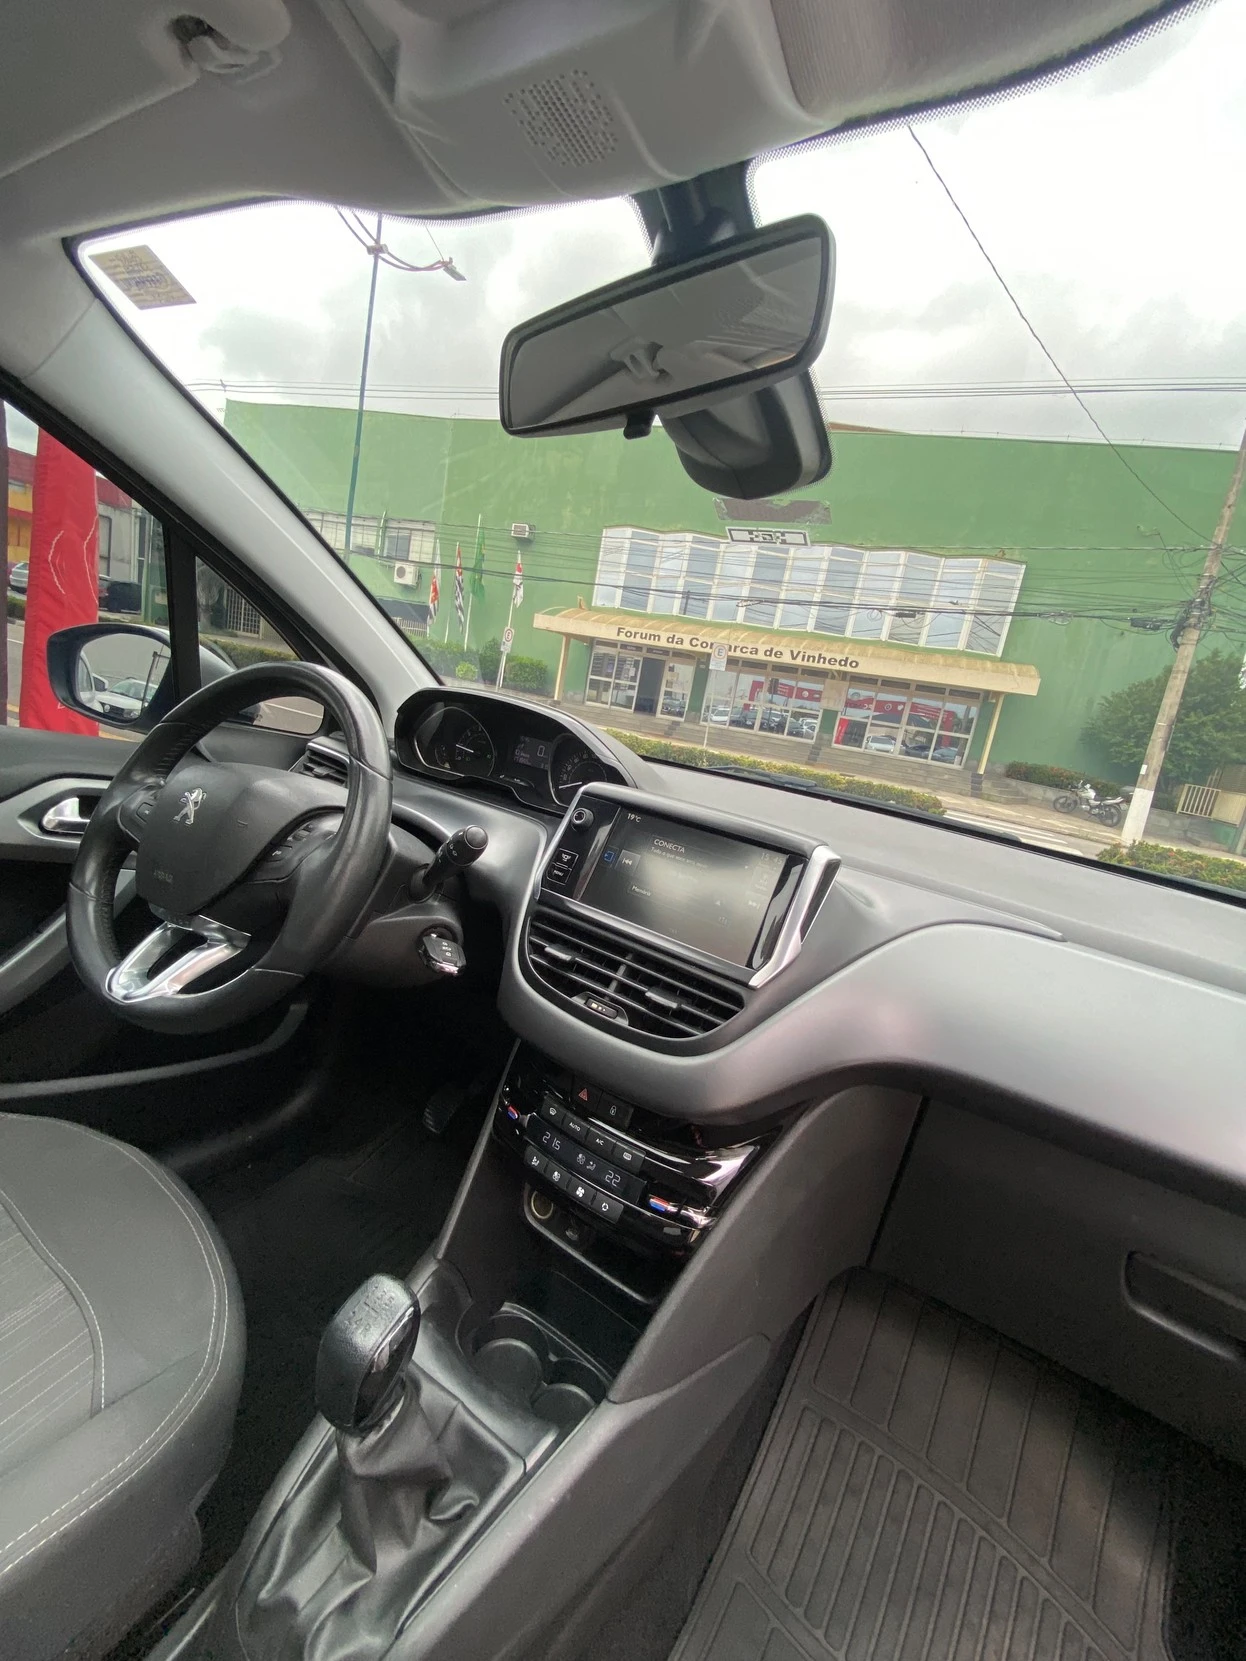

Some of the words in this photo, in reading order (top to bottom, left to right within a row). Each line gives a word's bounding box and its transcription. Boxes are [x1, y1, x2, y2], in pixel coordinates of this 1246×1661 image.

[616, 627, 661, 642] Forum
[666, 634, 684, 646] da
[763, 647, 783, 659] de
[789, 649, 860, 669] Vinhedo
[653, 839, 685, 853] CONECTA
[569, 1122, 581, 1131] AUTO
[605, 1170, 621, 1187] 22
